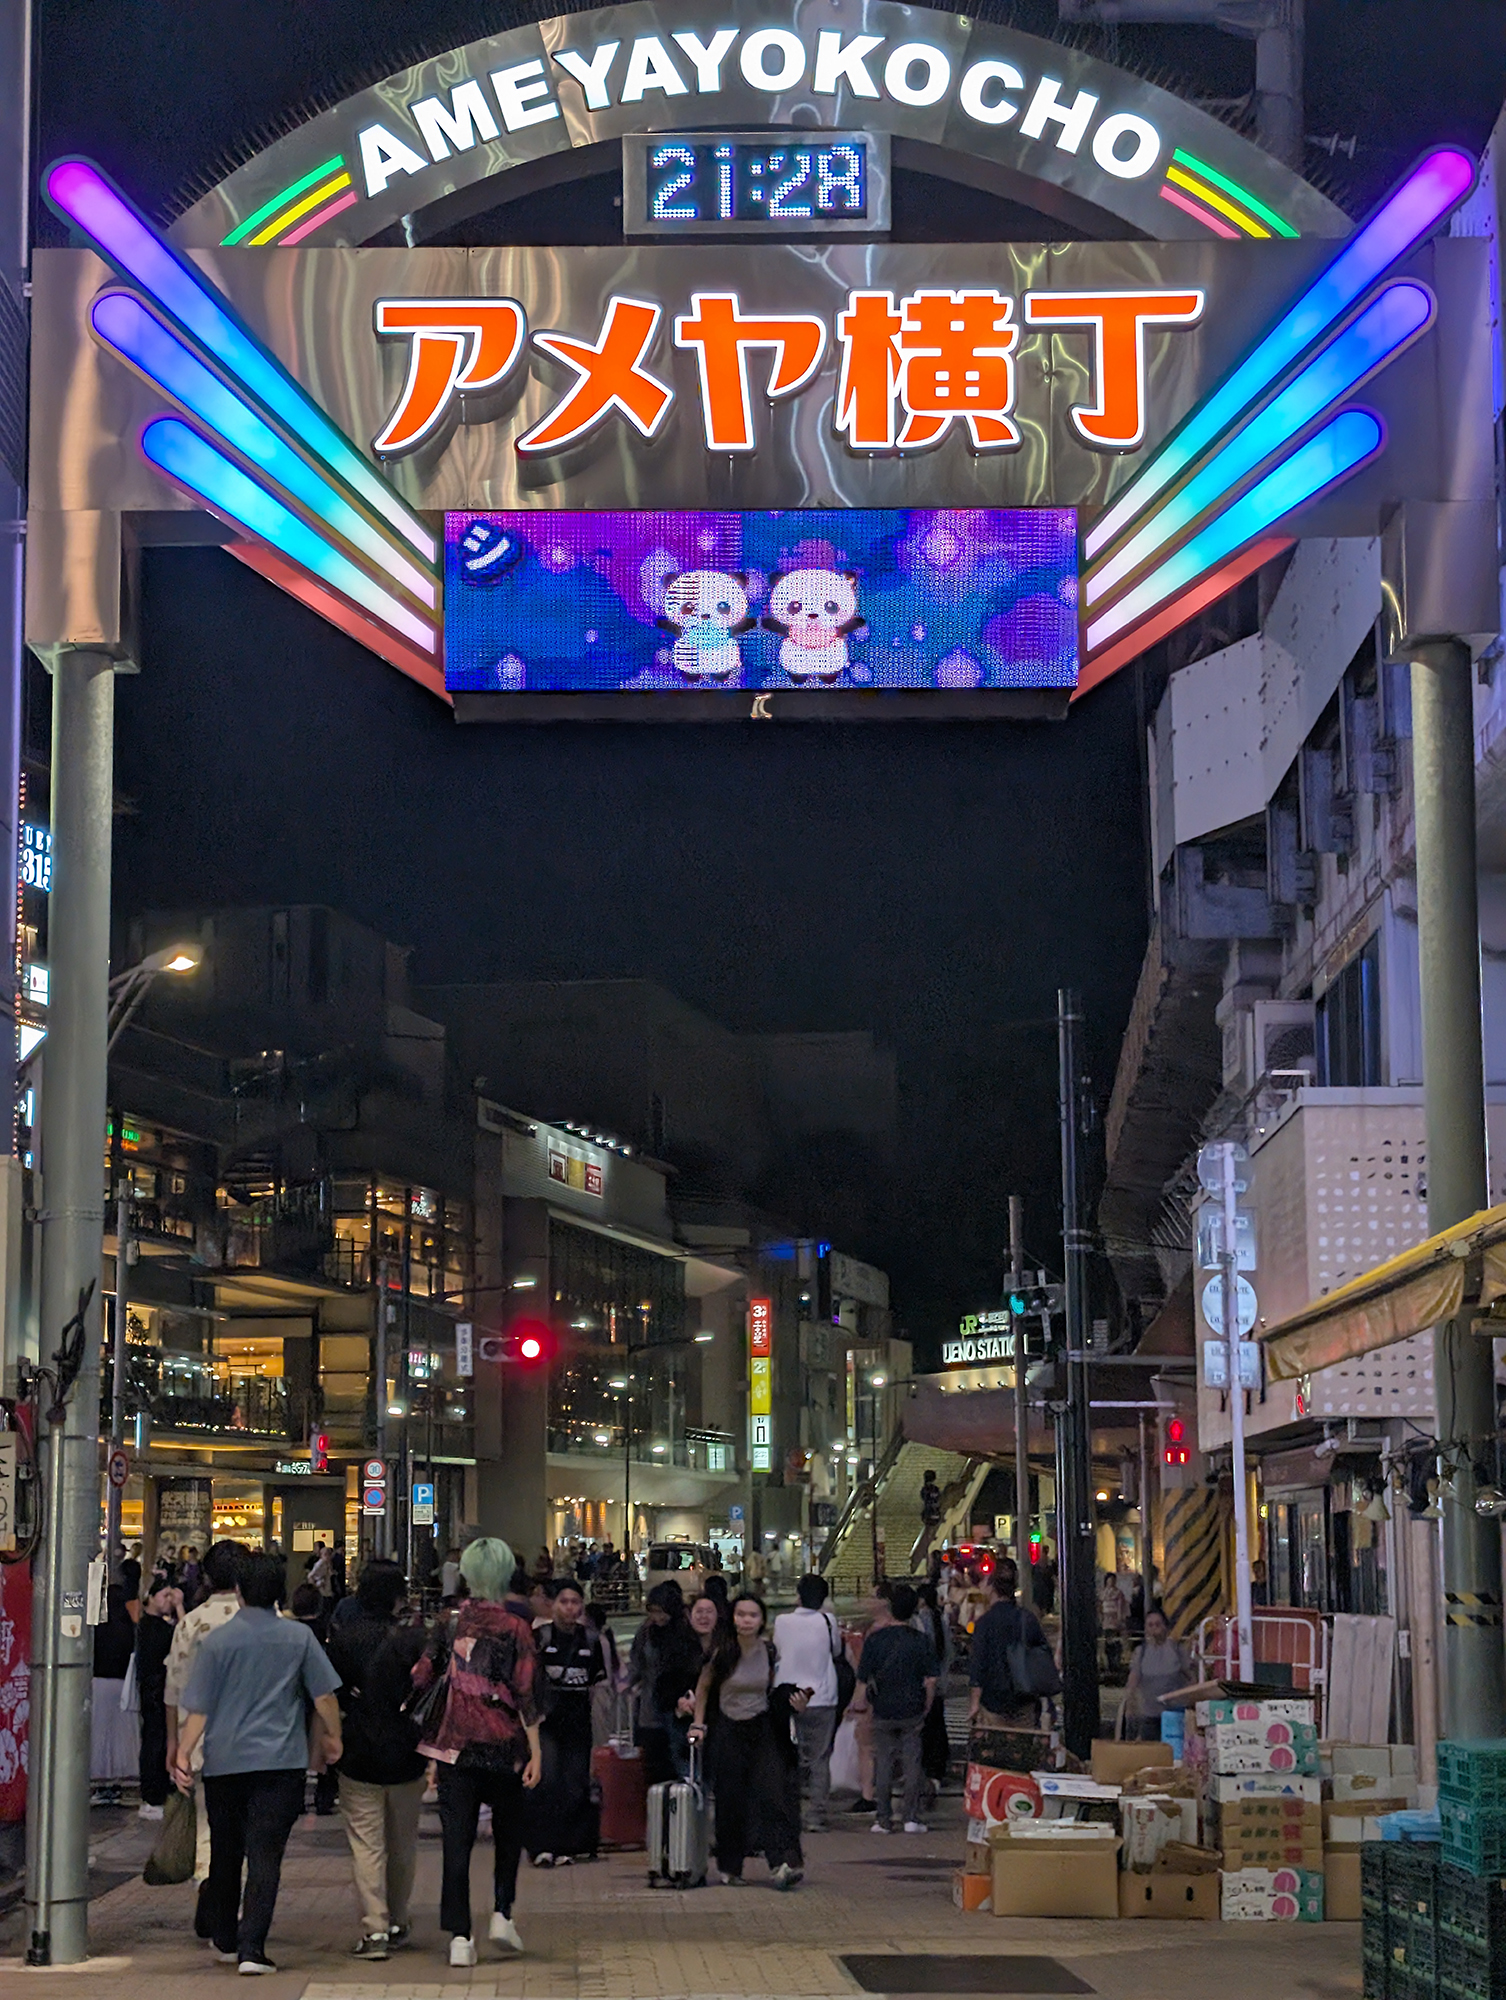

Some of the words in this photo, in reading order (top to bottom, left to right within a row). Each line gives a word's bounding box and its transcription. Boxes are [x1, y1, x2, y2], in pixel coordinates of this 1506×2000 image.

[356, 28, 1161, 198] AMEYAYOKOCHO
[372, 290, 1206, 455] アメヤ横丁
[959, 1314, 977, 1336] JR
[942, 1340, 977, 1363] UENO
[977, 1333, 1029, 1360] STATIO
[369, 1464, 381, 1475] 30
[418, 1487, 429, 1502] P
